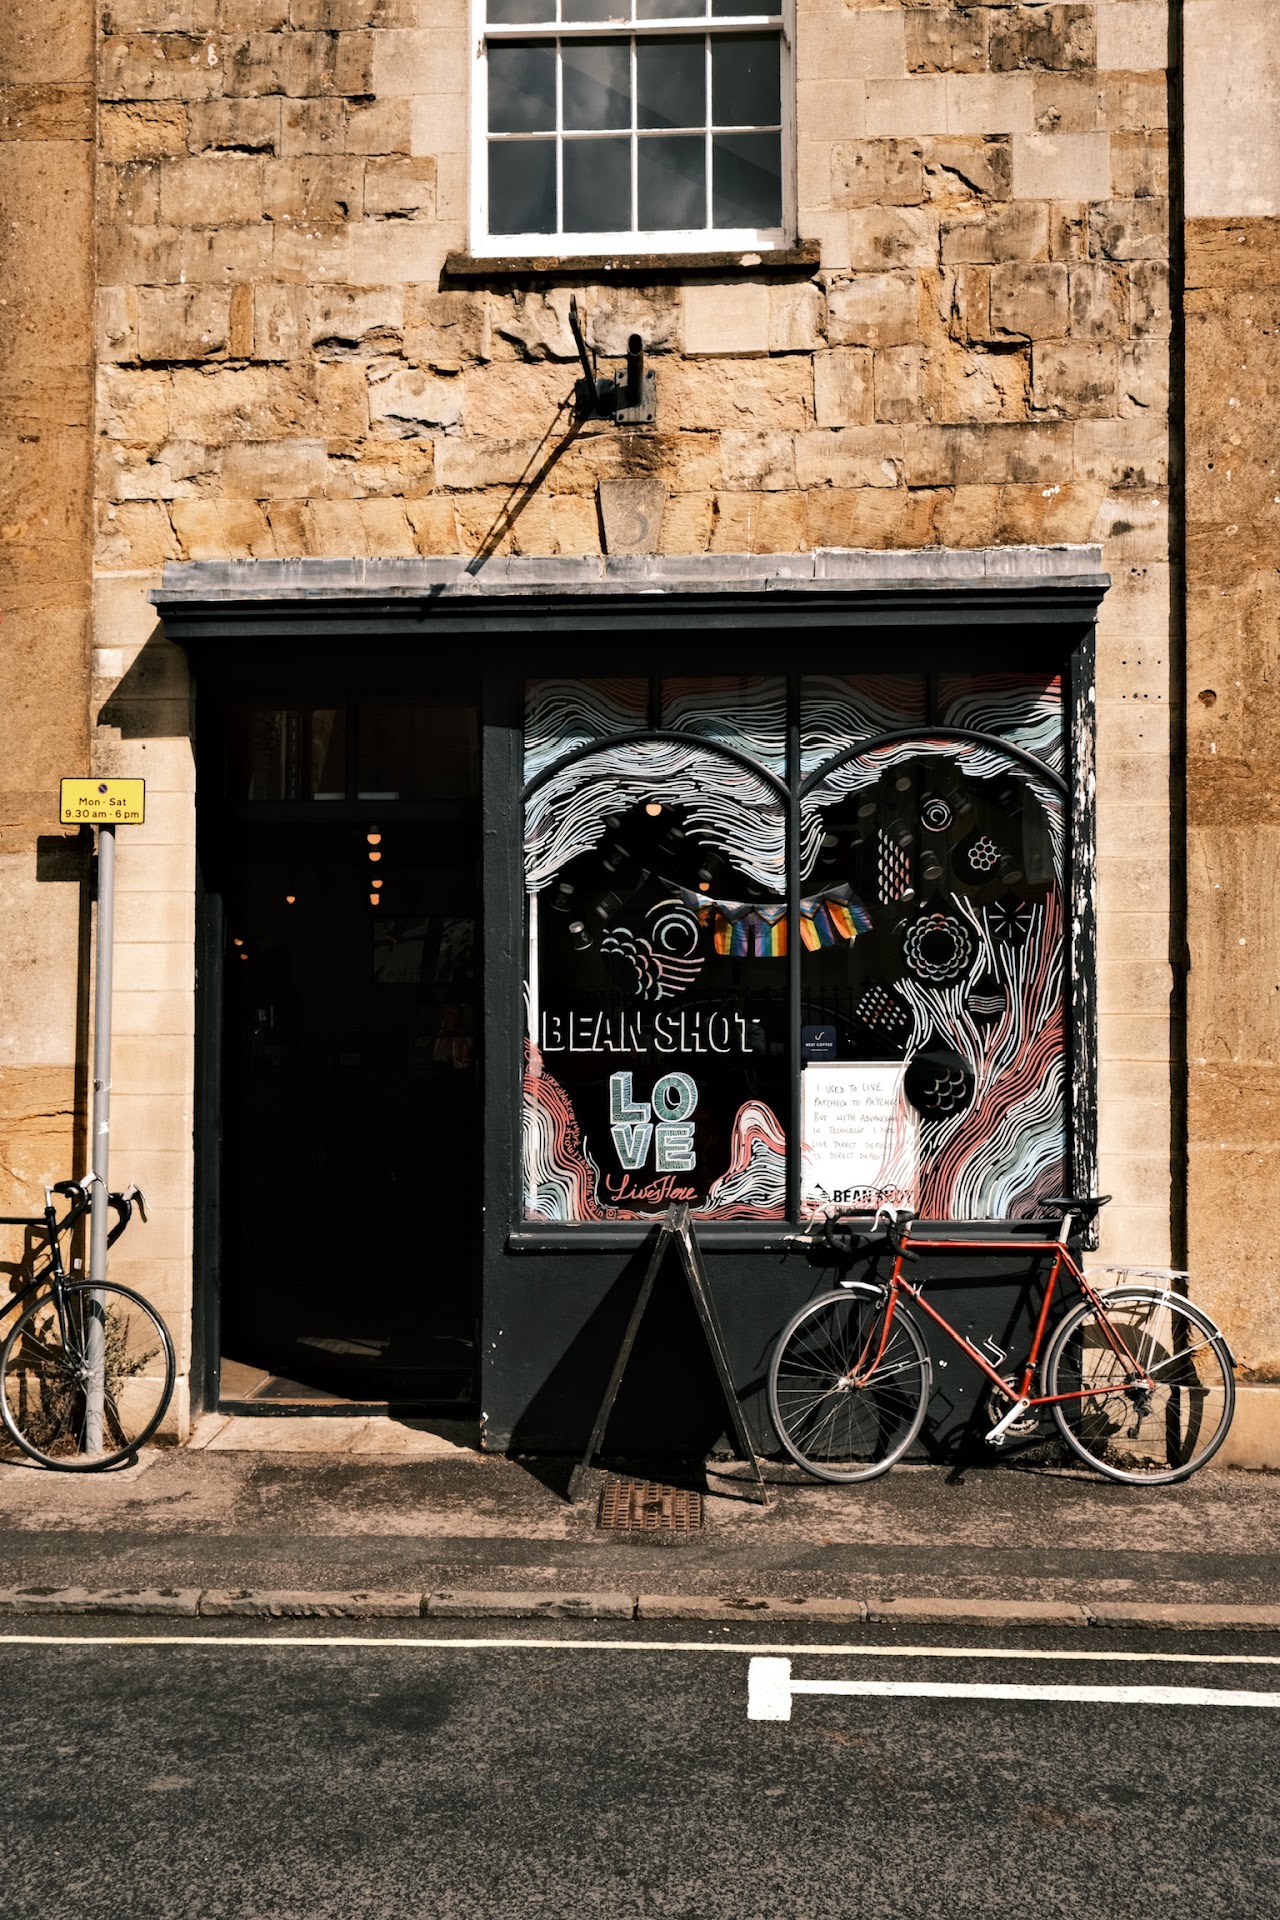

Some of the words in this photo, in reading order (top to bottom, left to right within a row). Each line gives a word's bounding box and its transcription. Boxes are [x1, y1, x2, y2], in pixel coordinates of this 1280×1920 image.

[79, 797, 100, 806] Mon
[109, 797, 126, 806] Sat
[65, 809, 89, 818] 9.30
[115, 809, 121, 818] 6
[124, 811, 139, 819] pm
[542, 1011, 648, 1052] BEAN
[654, 1011, 760, 1053] SHOT
[825, 1085, 845, 1094] USED
[848, 1084, 858, 1093] TO
[862, 1081, 884, 1092] LIVE
[814, 1097, 848, 1108] PAYCHECK
[850, 1099, 860, 1107] TO
[865, 1096, 901, 1106] PAYCHEC
[813, 1111, 828, 1122] BUT
[836, 1113, 856, 1122] WITH
[813, 1127, 821, 1135] IN
[811, 1140, 828, 1149] LIVE
[811, 1153, 821, 1161] TO
[833, 1189, 872, 1203] BEAN
